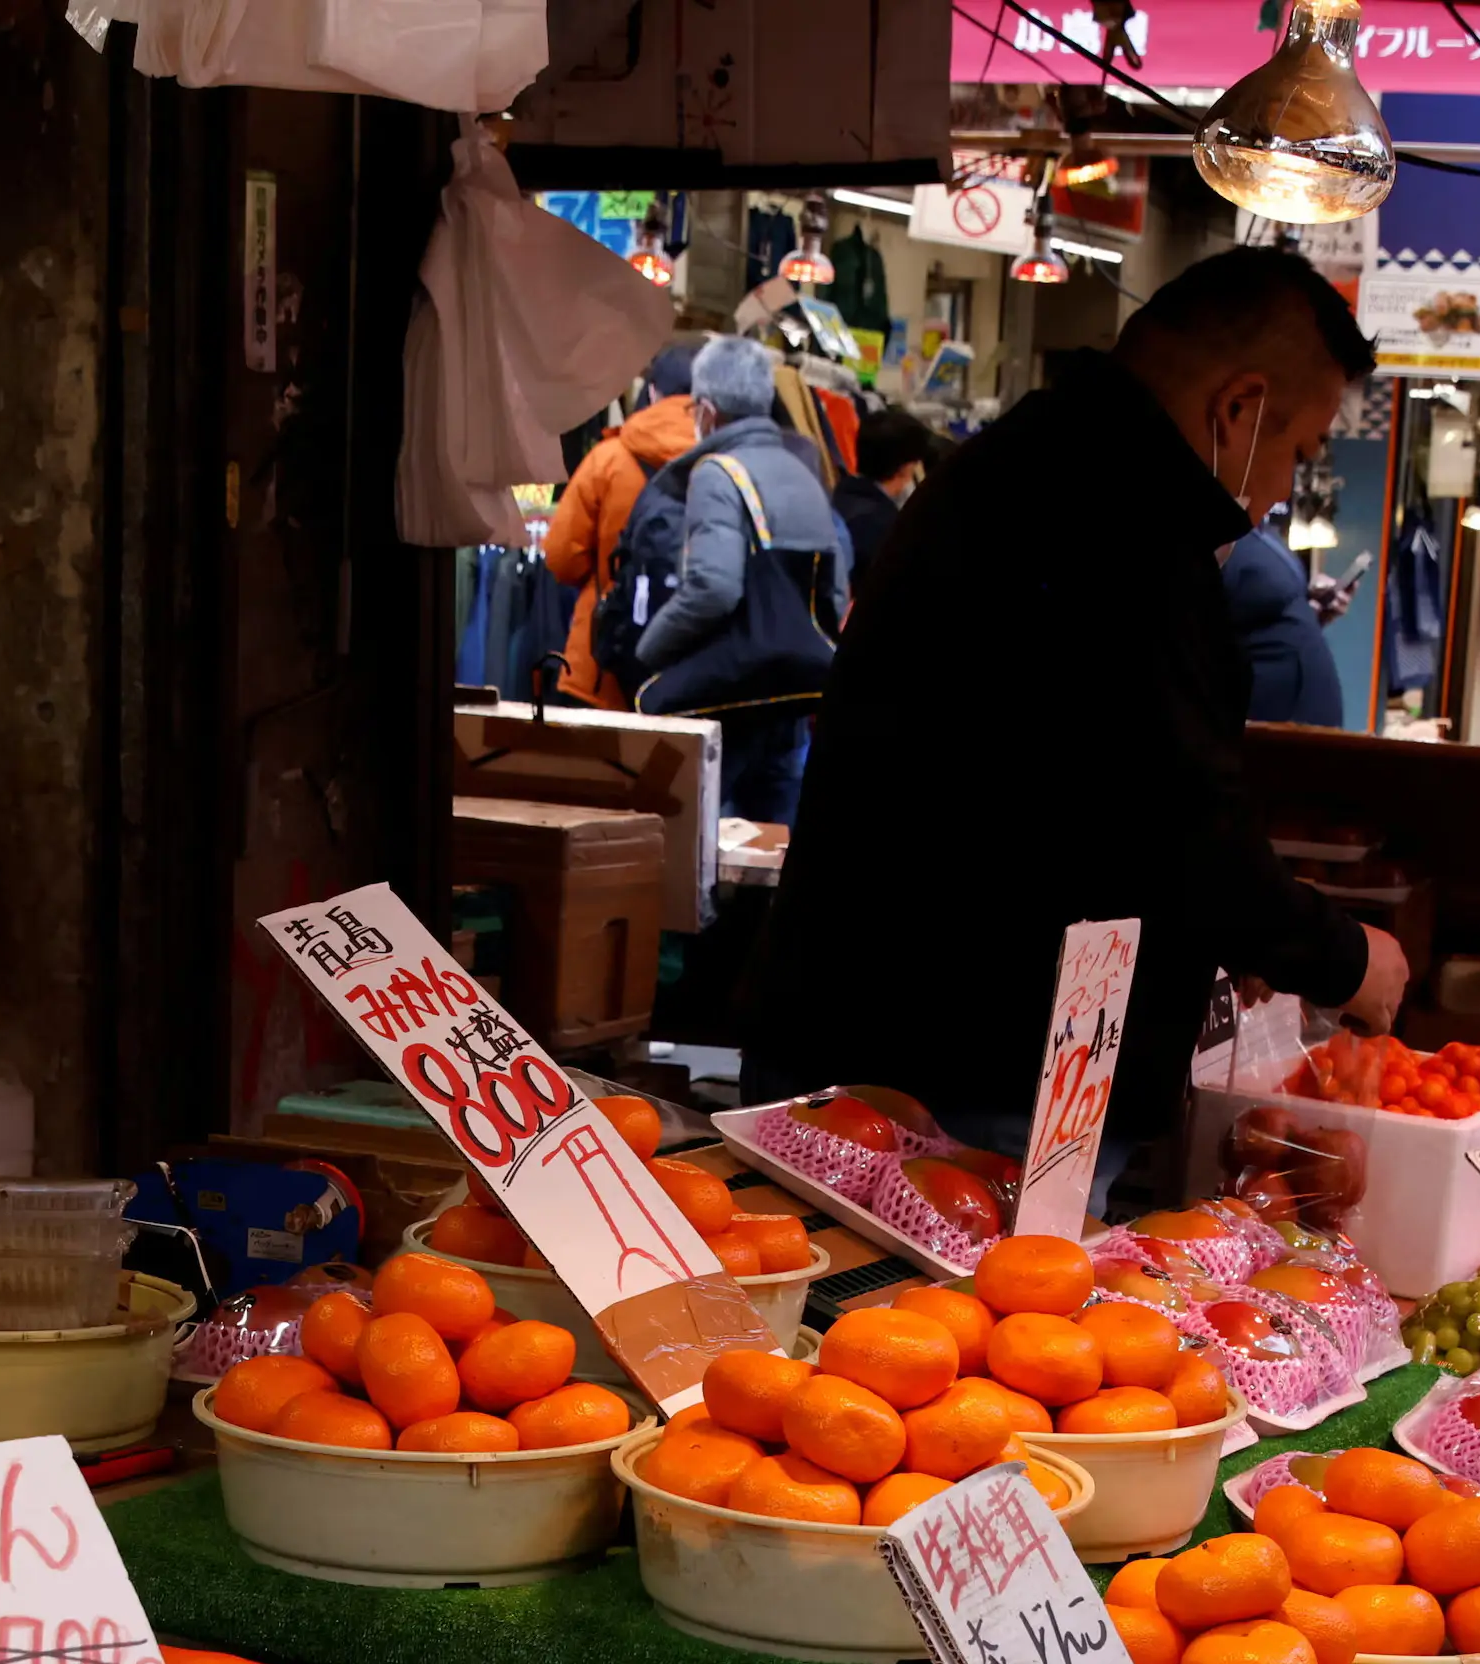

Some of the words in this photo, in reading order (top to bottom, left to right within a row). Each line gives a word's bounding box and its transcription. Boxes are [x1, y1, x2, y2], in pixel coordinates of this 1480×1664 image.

[284, 904, 394, 979] 青島
[344, 956, 478, 1043] みかん
[400, 1041, 577, 1168] 800
